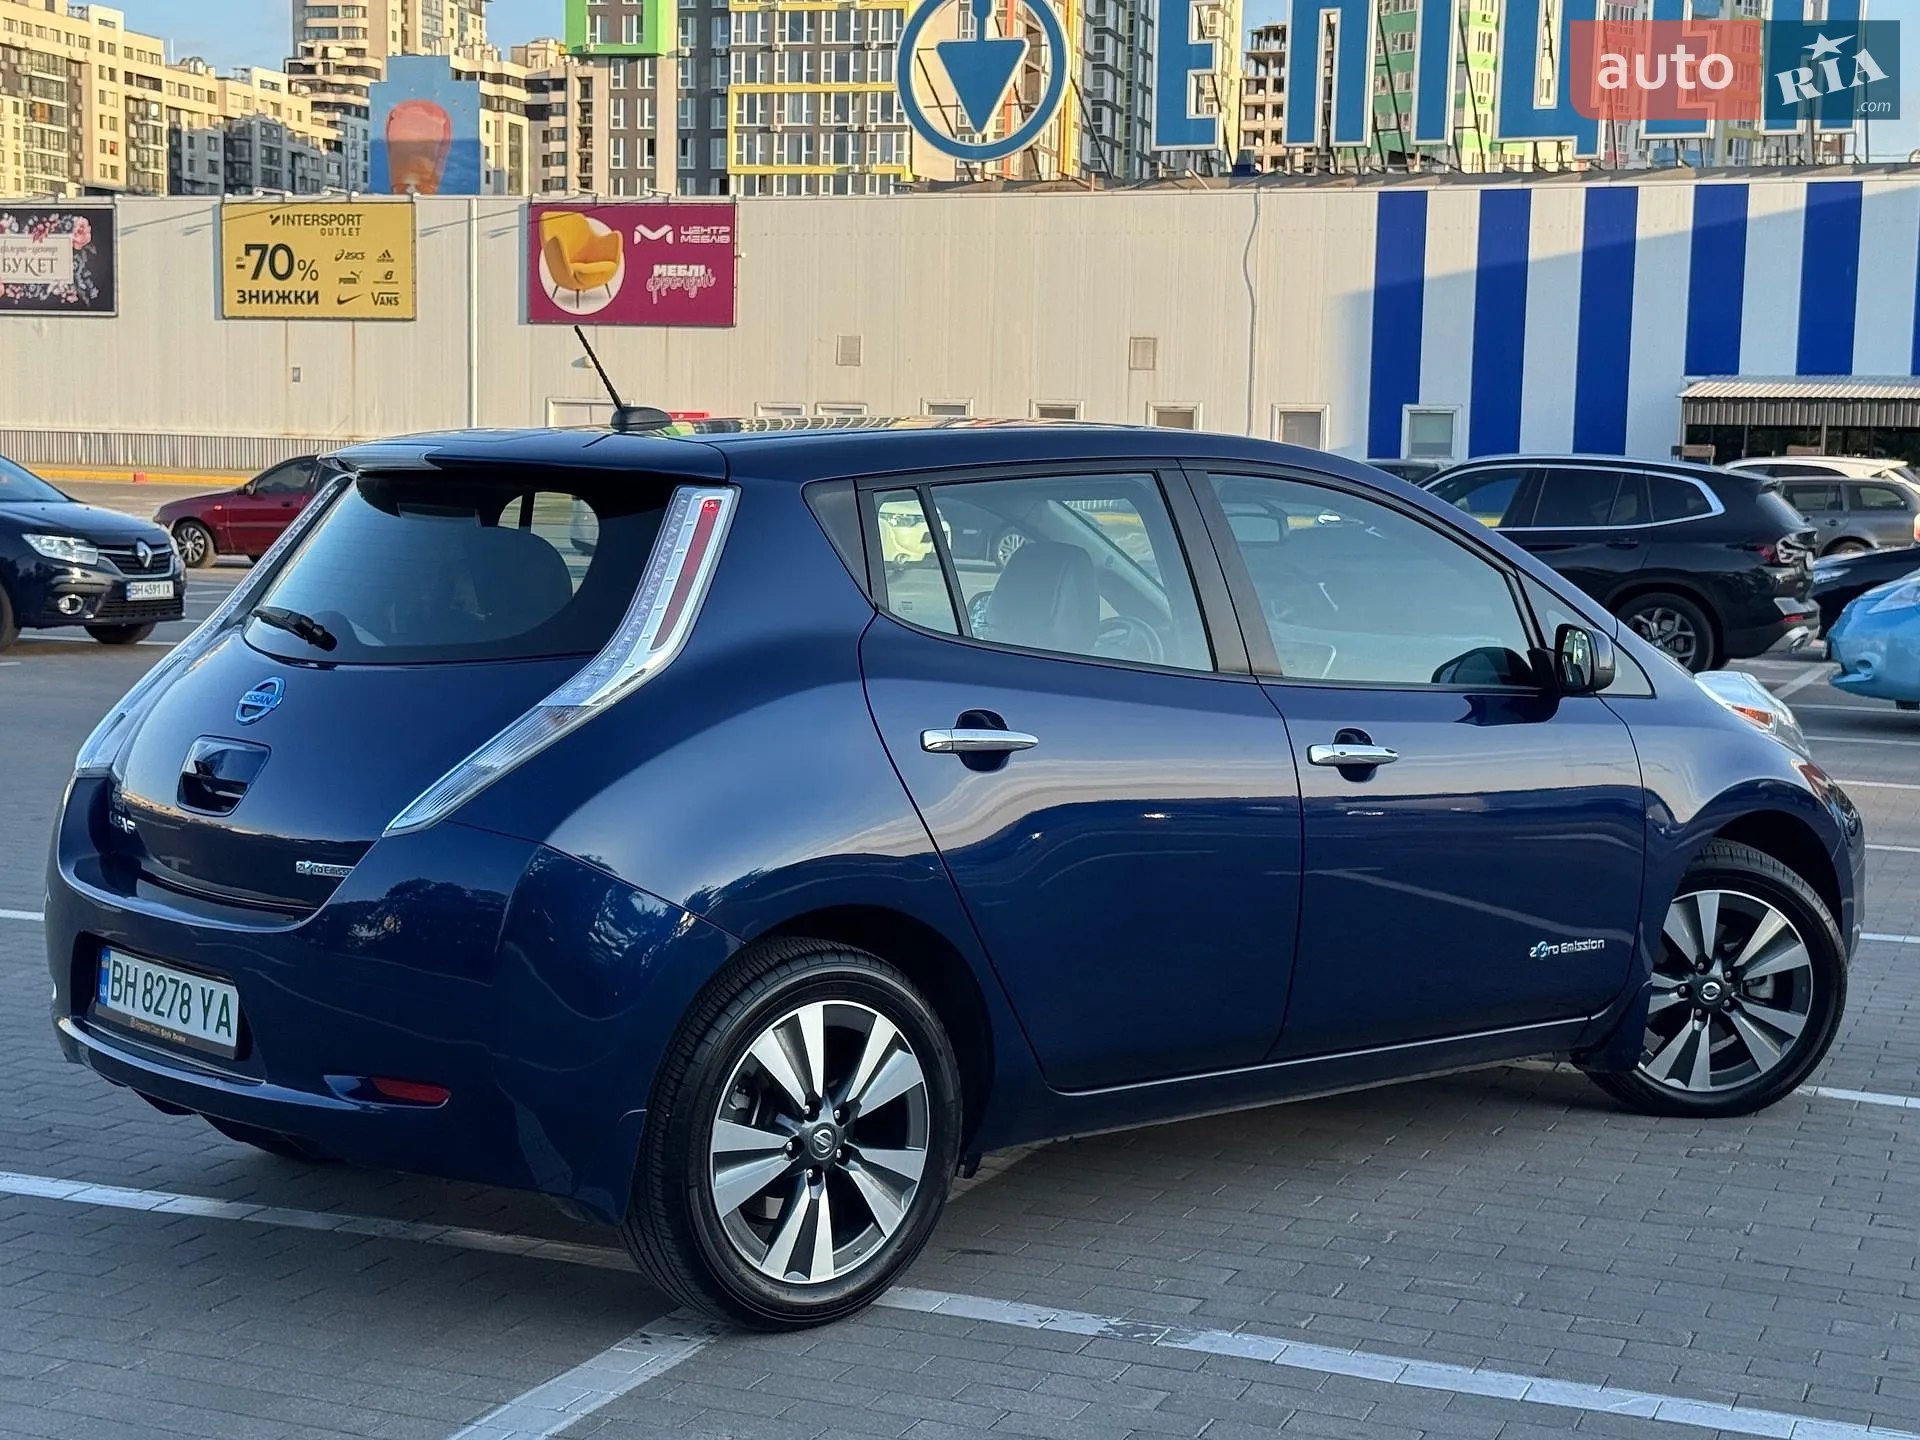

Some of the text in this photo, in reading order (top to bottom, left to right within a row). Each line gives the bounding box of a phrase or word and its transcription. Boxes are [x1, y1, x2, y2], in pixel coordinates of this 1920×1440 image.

[282, 213, 363, 226] INTERSPORT
[320, 227, 361, 237] OUTLET
[680, 225, 731, 235] ЦЕНТР
[2, 257, 58, 277] БУКЕТ
[236, 243, 319, 281] -70%
[653, 264, 706, 277] МЕБЛІ
[236, 289, 319, 305] ЗНИЖКИ
[1560, 938, 1605, 954] Emission
[110, 960, 138, 1009] BH
[141, 971, 192, 1025] 8278
[200, 986, 232, 1038] YA
